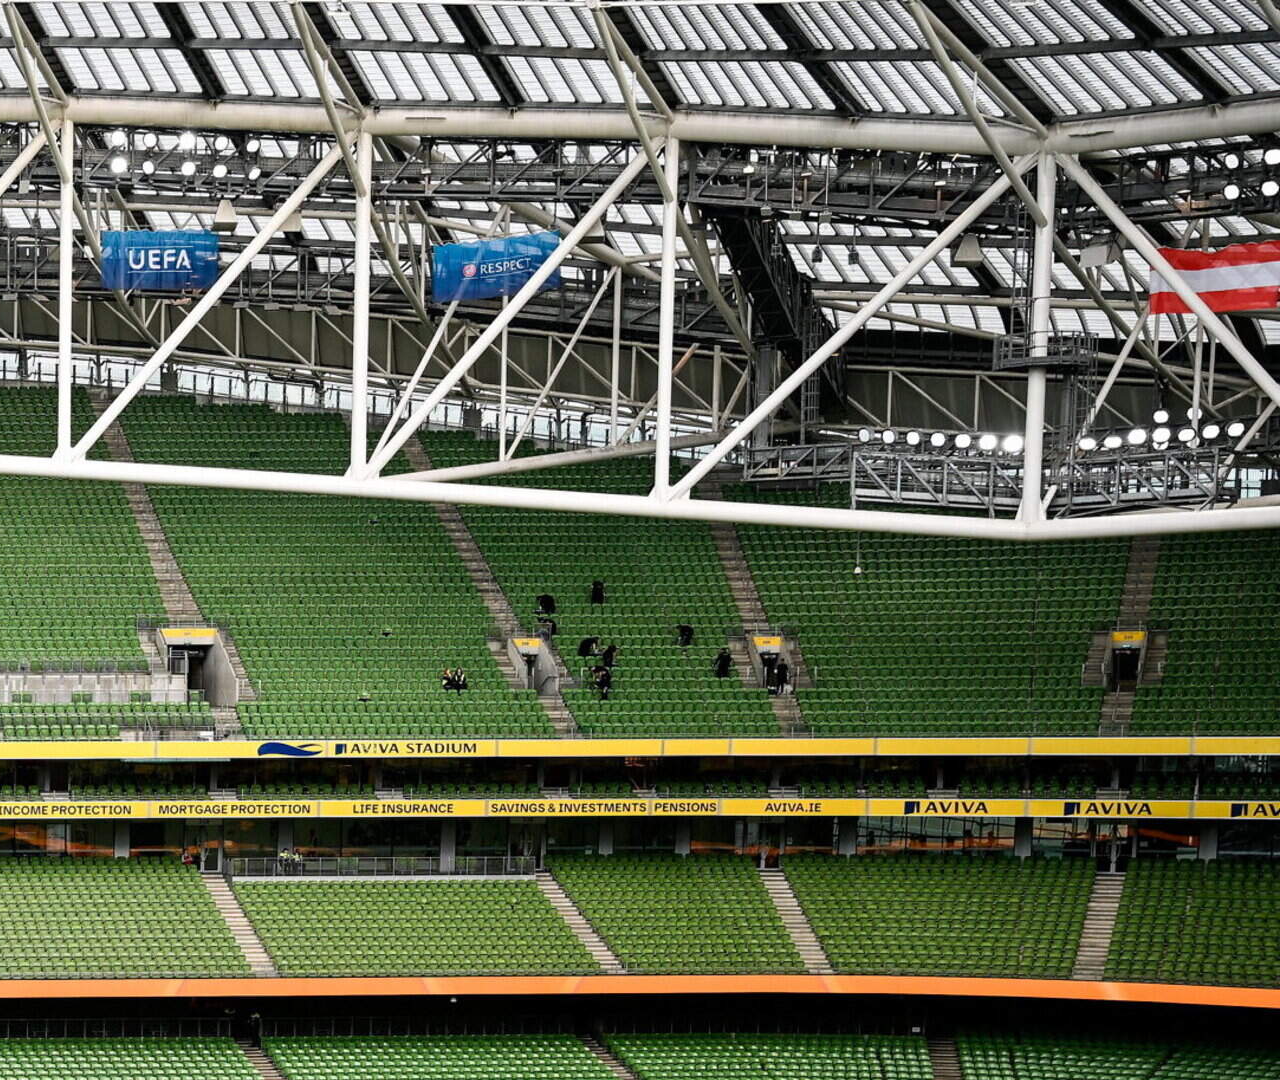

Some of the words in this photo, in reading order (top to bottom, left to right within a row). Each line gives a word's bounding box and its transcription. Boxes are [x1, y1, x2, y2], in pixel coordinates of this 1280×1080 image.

[129, 249, 192, 270] UEFA
[480, 258, 532, 274] RESPECT
[351, 744, 399, 753] AVIVA
[407, 743, 476, 753] STADIUM
[0, 806, 48, 815] INCOME
[52, 805, 131, 815] PROTECTION
[159, 805, 227, 814] MORTGAGE
[231, 805, 310, 814] PROTECTION
[353, 804, 378, 813] LIFE
[382, 804, 453, 813] INSURANCE
[492, 803, 545, 813] SAVINGS
[548, 804, 555, 812] &
[559, 803, 646, 812] INVESTMENTS
[655, 803, 716, 812] PENSIONS
[765, 803, 821, 812] AVIVA.IE
[925, 802, 988, 813] AVIVA
[1086, 803, 1152, 815] AVIVA
